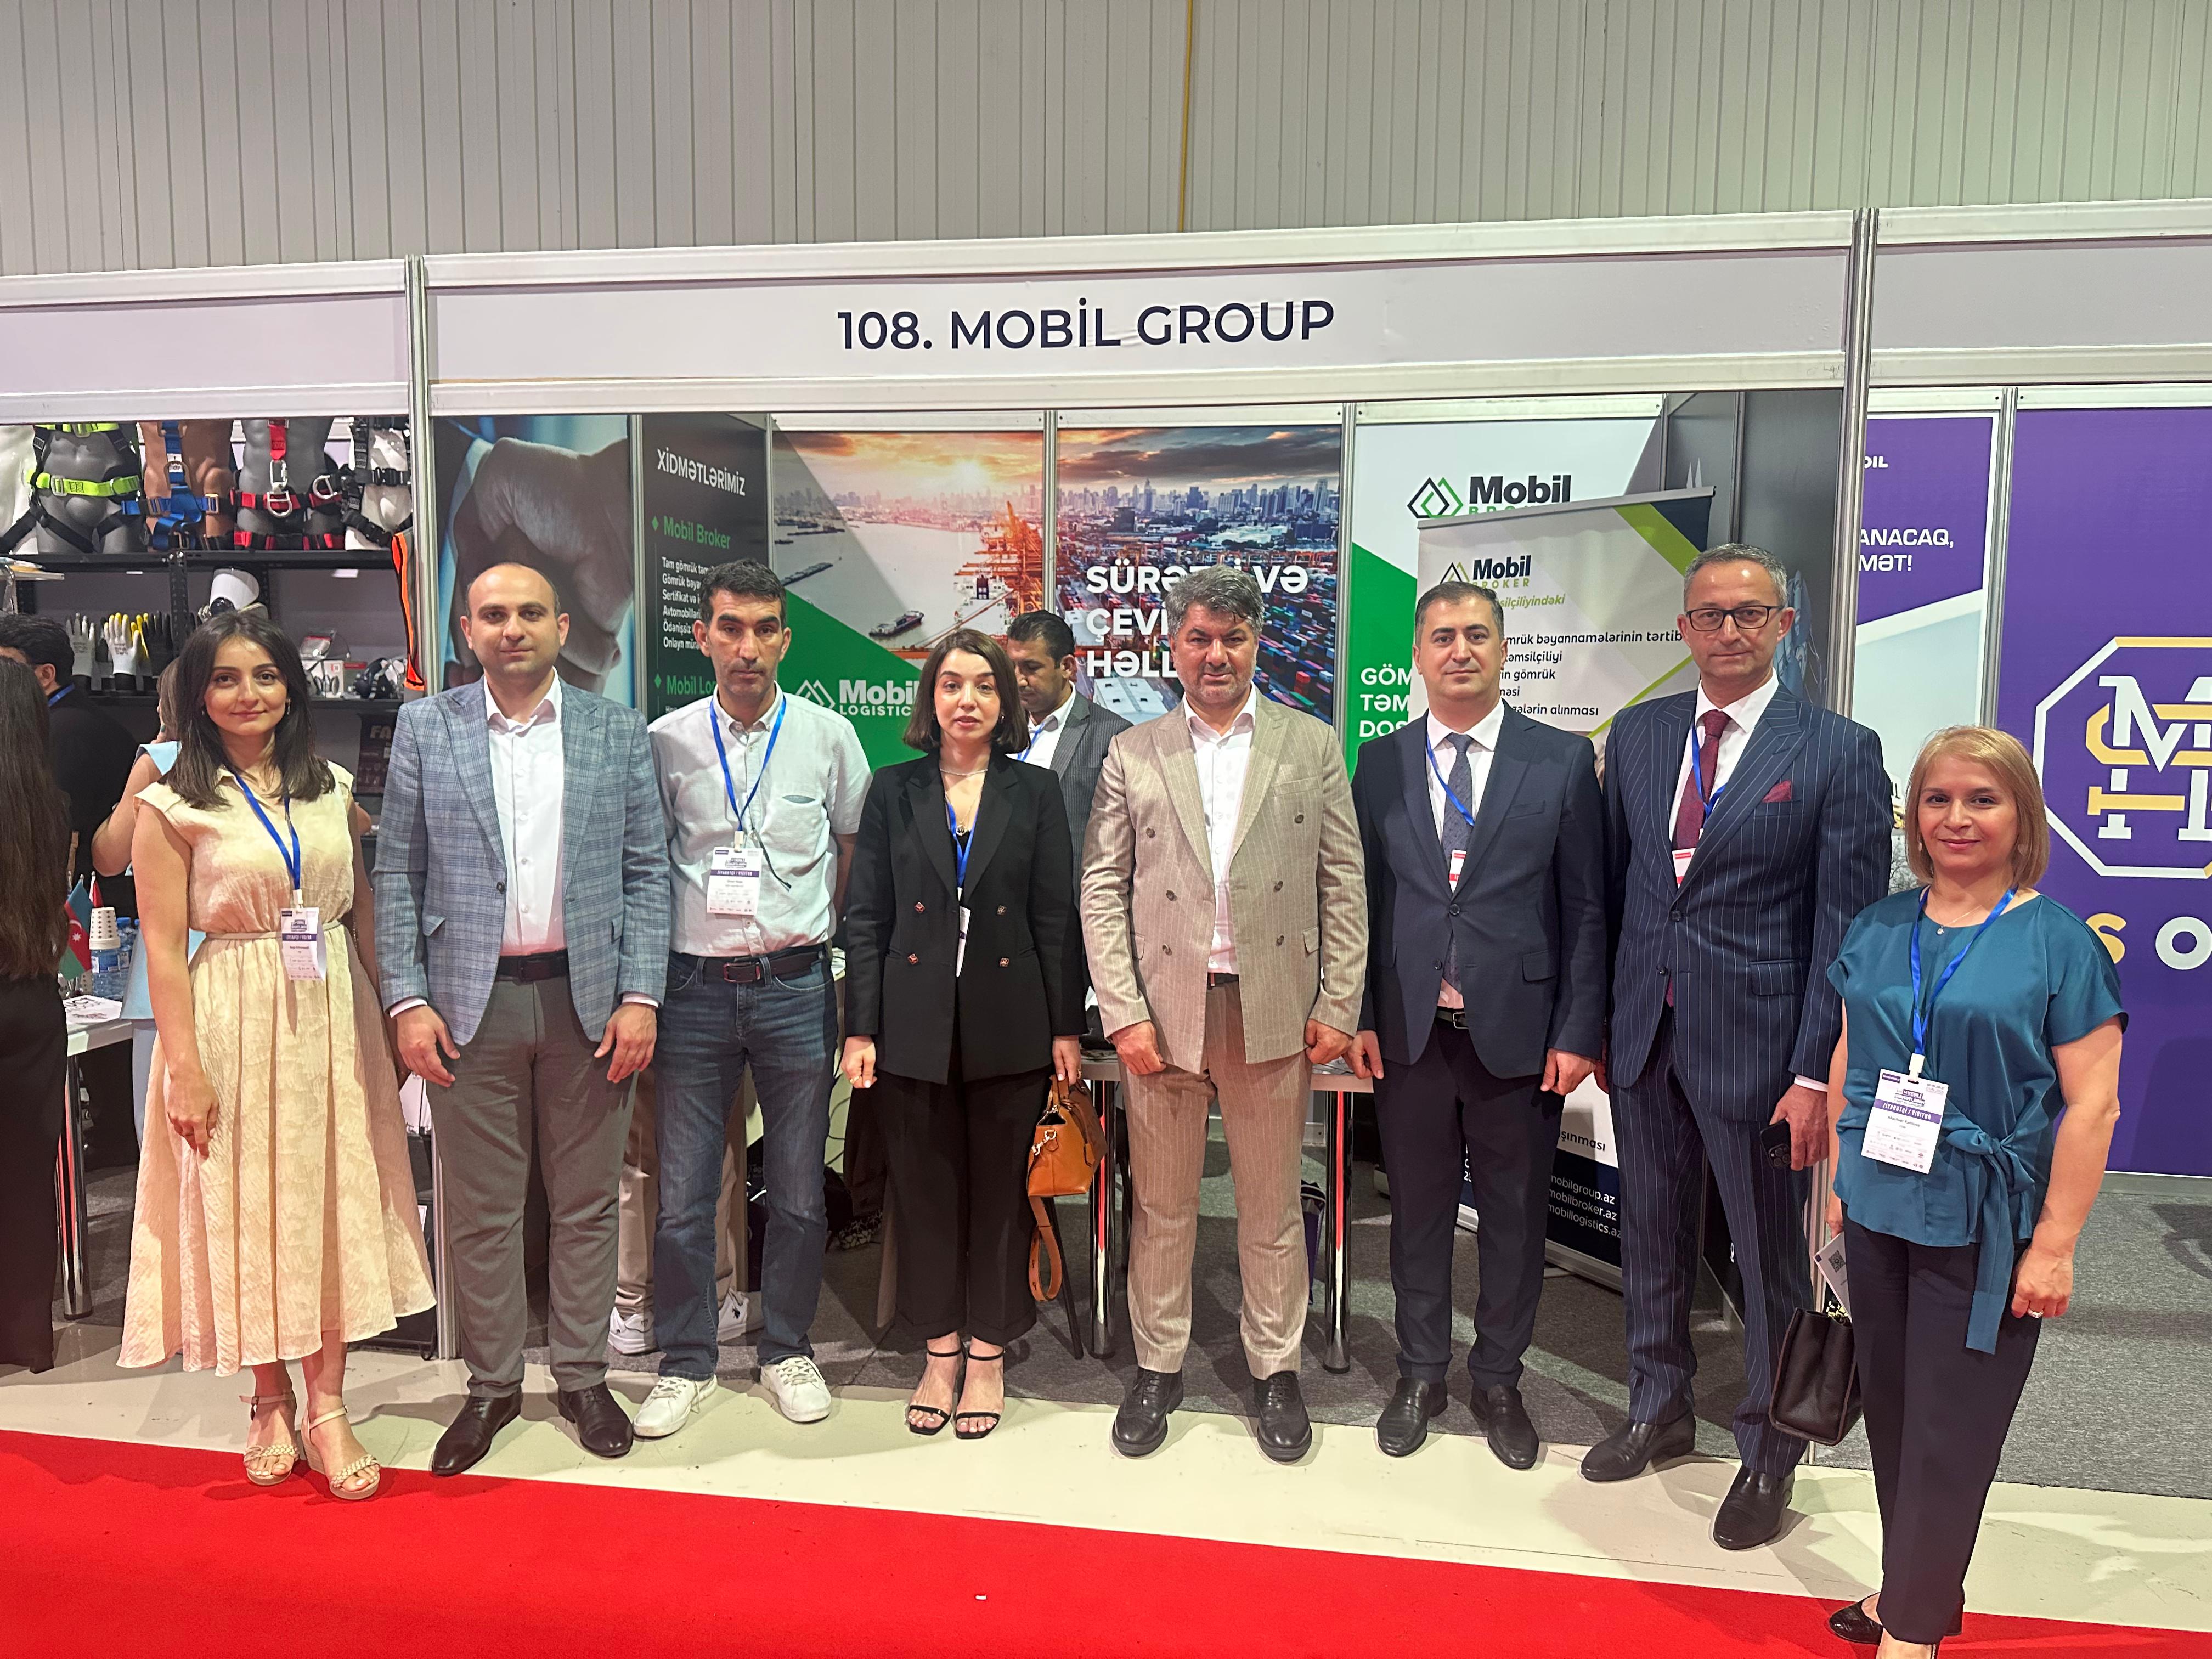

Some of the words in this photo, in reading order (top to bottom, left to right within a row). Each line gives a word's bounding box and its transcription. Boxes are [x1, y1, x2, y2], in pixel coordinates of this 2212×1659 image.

[838, 311, 932, 350] 108.
[951, 297, 1121, 349] MOBİL
[1137, 300, 1334, 346] GROUP
[657, 447, 746, 496] XİDMƏTLƏRİMİZ
[1469, 475, 1571, 504] Mobil
[664, 515, 694, 542] Mobil
[697, 523, 731, 550] Broker
[662, 556, 675, 570] Tam
[675, 559, 698, 573] gömrük
[1472, 555, 1532, 580] Mobil
[662, 572, 686, 587] Gömrük
[663, 589, 689, 603] Sertifikat
[1499, 593, 1566, 610] silçiliyindəki
[663, 636, 684, 651] Onlayn
[1536, 630, 1643, 646] bəyannamələrinin
[1514, 668, 1556, 681] gömrük
[667, 675, 697, 695] Mobil
[1550, 704, 1599, 716] alınması
